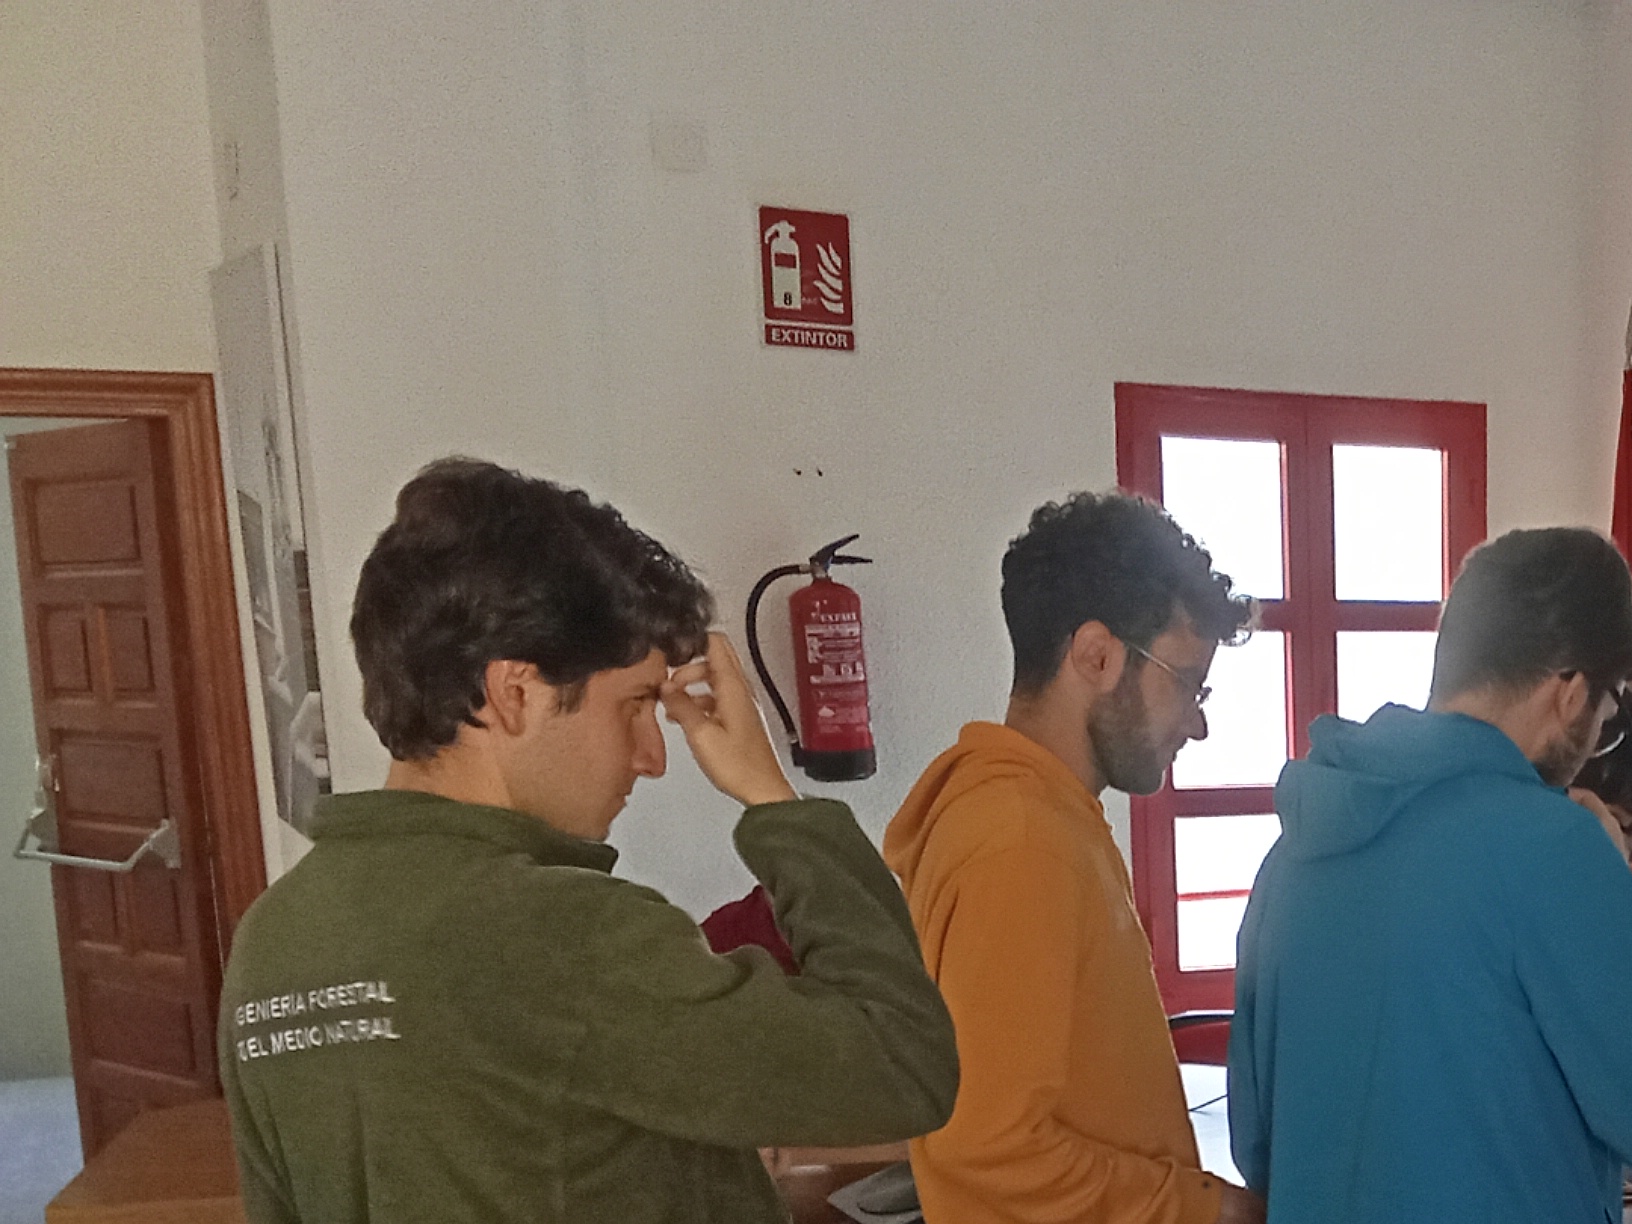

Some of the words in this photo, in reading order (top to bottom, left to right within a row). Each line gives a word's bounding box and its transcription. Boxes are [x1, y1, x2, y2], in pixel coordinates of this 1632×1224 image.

[771, 328, 848, 347] EXTINTOR
[308, 981, 396, 1011] FORESTAL
[270, 1025, 323, 1055] MEDIO
[325, 1016, 401, 1044] NATURAL
